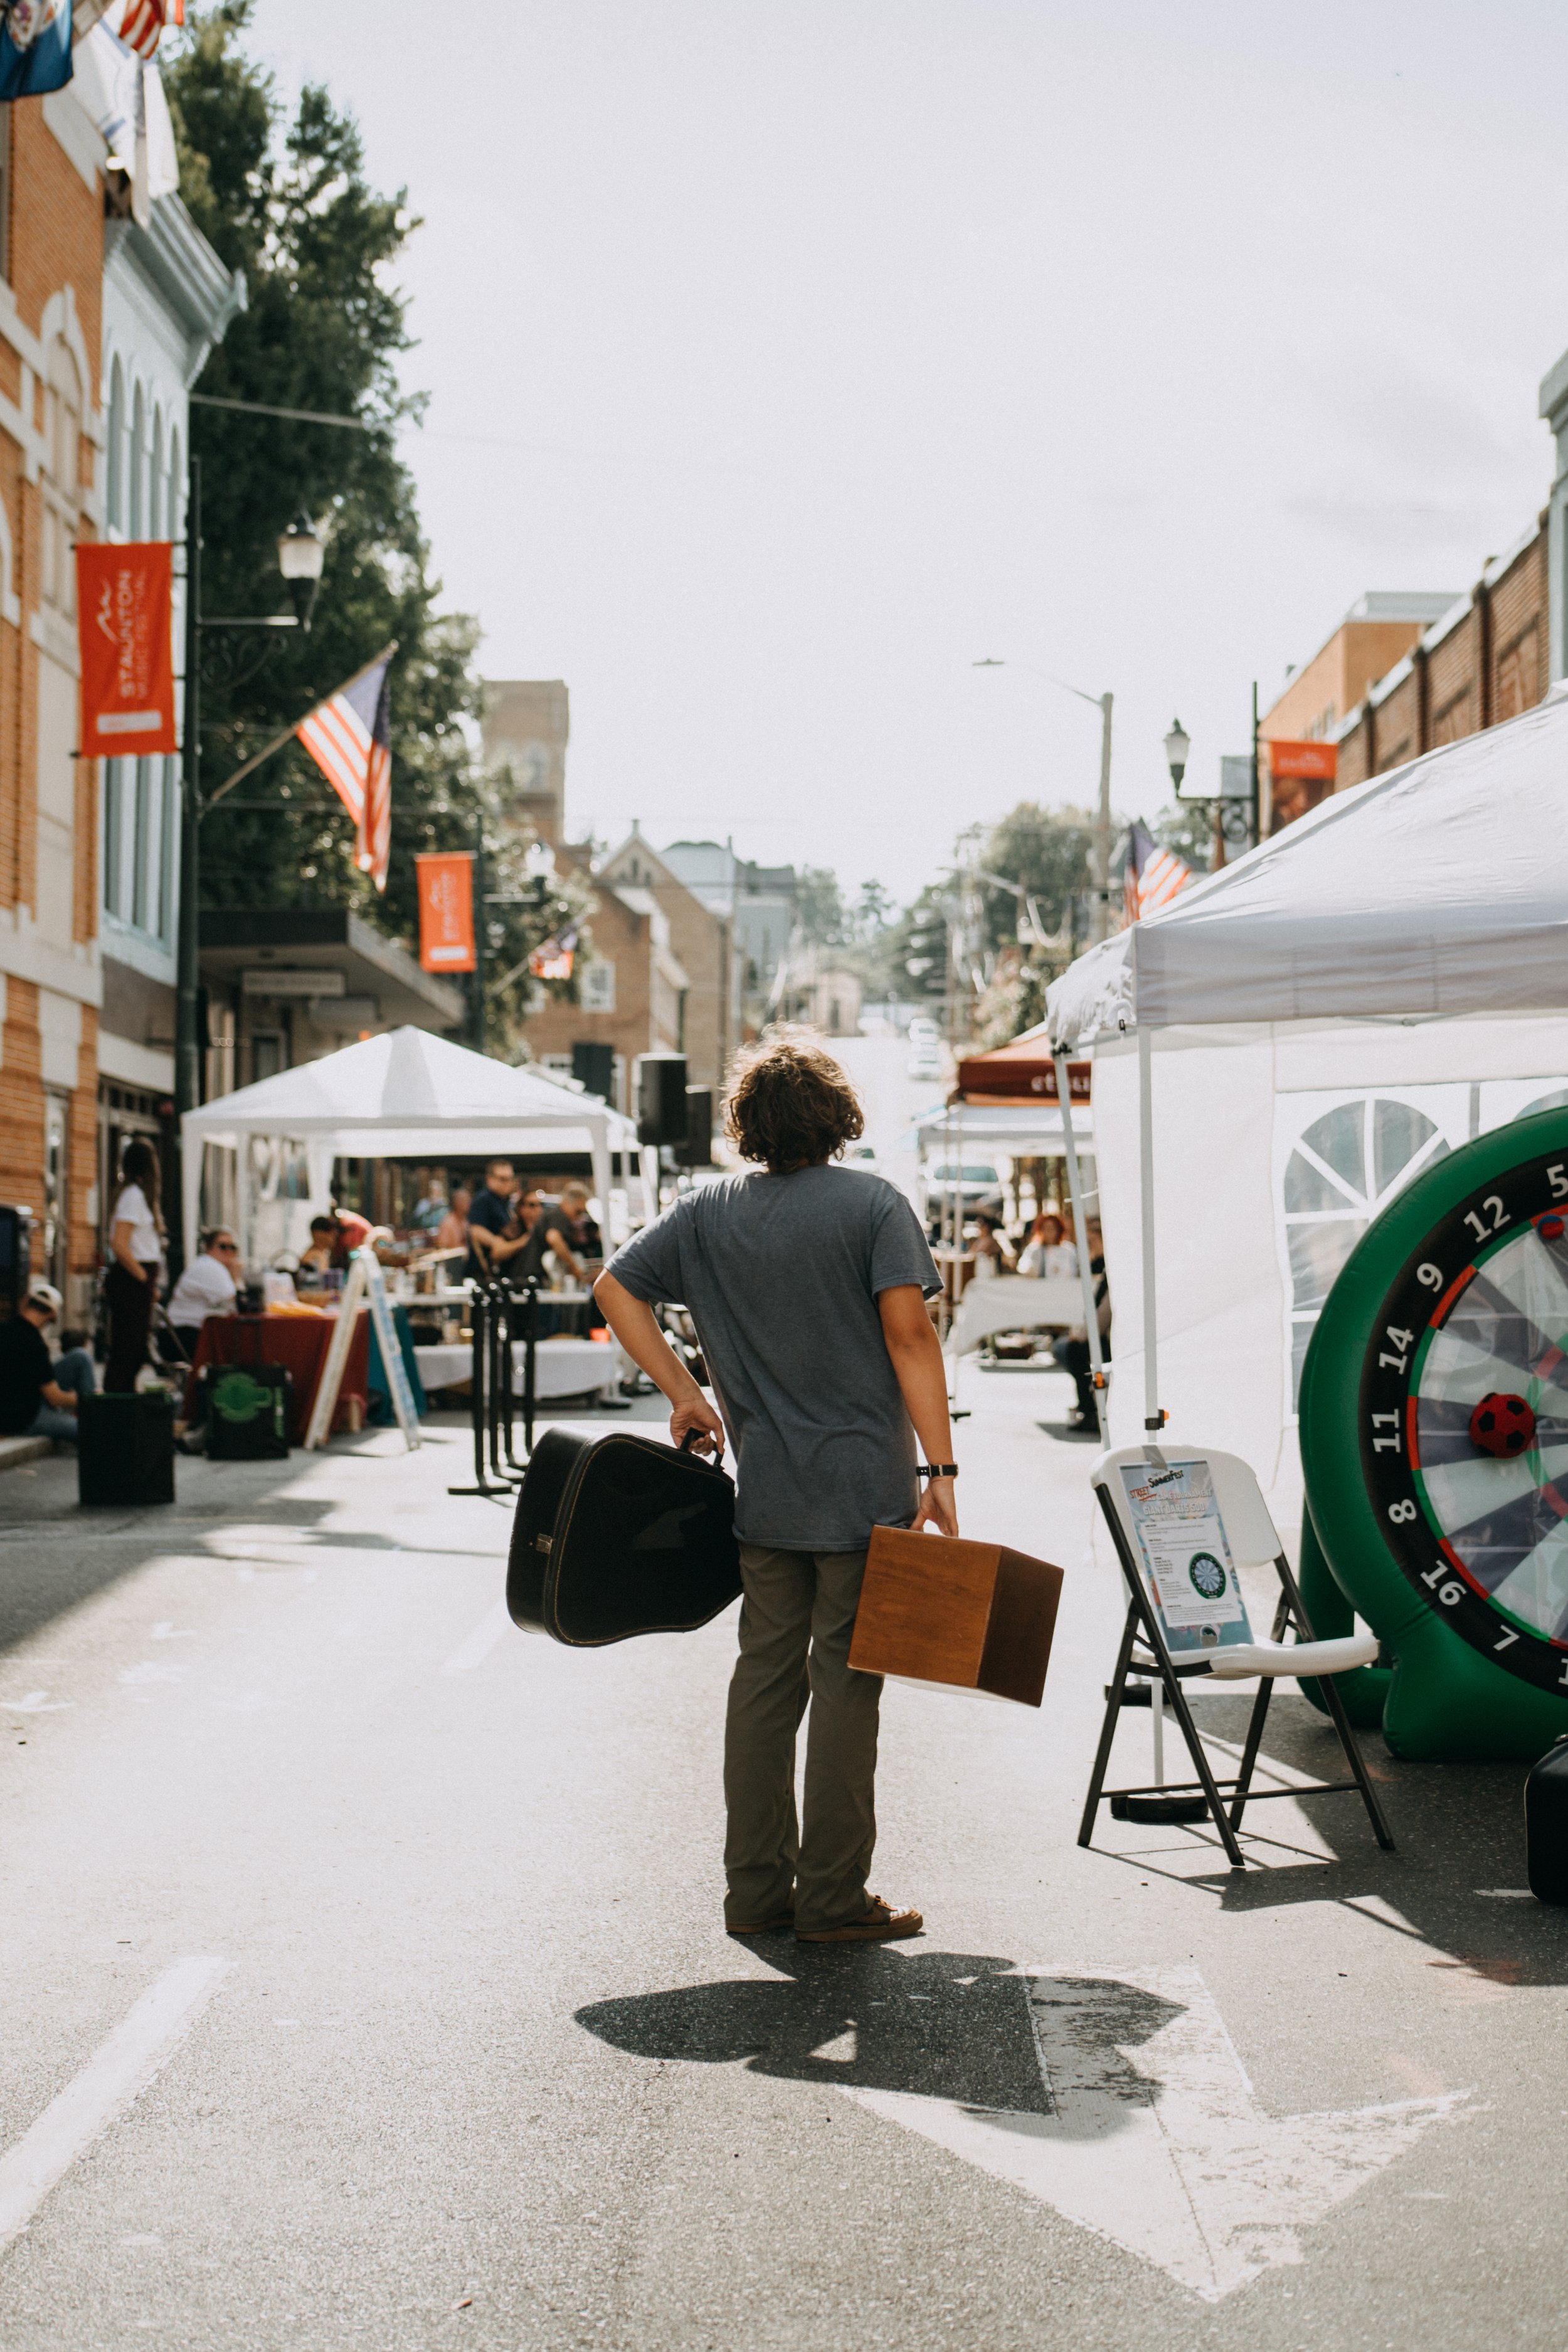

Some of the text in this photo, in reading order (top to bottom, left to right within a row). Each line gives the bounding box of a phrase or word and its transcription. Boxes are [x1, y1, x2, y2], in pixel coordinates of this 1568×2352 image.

[118, 569, 135, 699] STAUNTON
[1546, 1163, 1568, 1198] 5
[1463, 1195, 1511, 1243] 12
[1416, 1263, 1443, 1293] 9
[1379, 1326, 1414, 1375] 14
[1371, 1409, 1401, 1453] 11
[1129, 1486, 1150, 1499] STREET
[1143, 1502, 1206, 1515] GIANT DARTS 500
[1157, 1492, 1173, 1501] GAME
[1173, 1489, 1213, 1499] TOURNAMENT
[1388, 1498, 1417, 1523] 8
[1420, 1559, 1468, 1606] 16
[1493, 1624, 1520, 1651] 7
